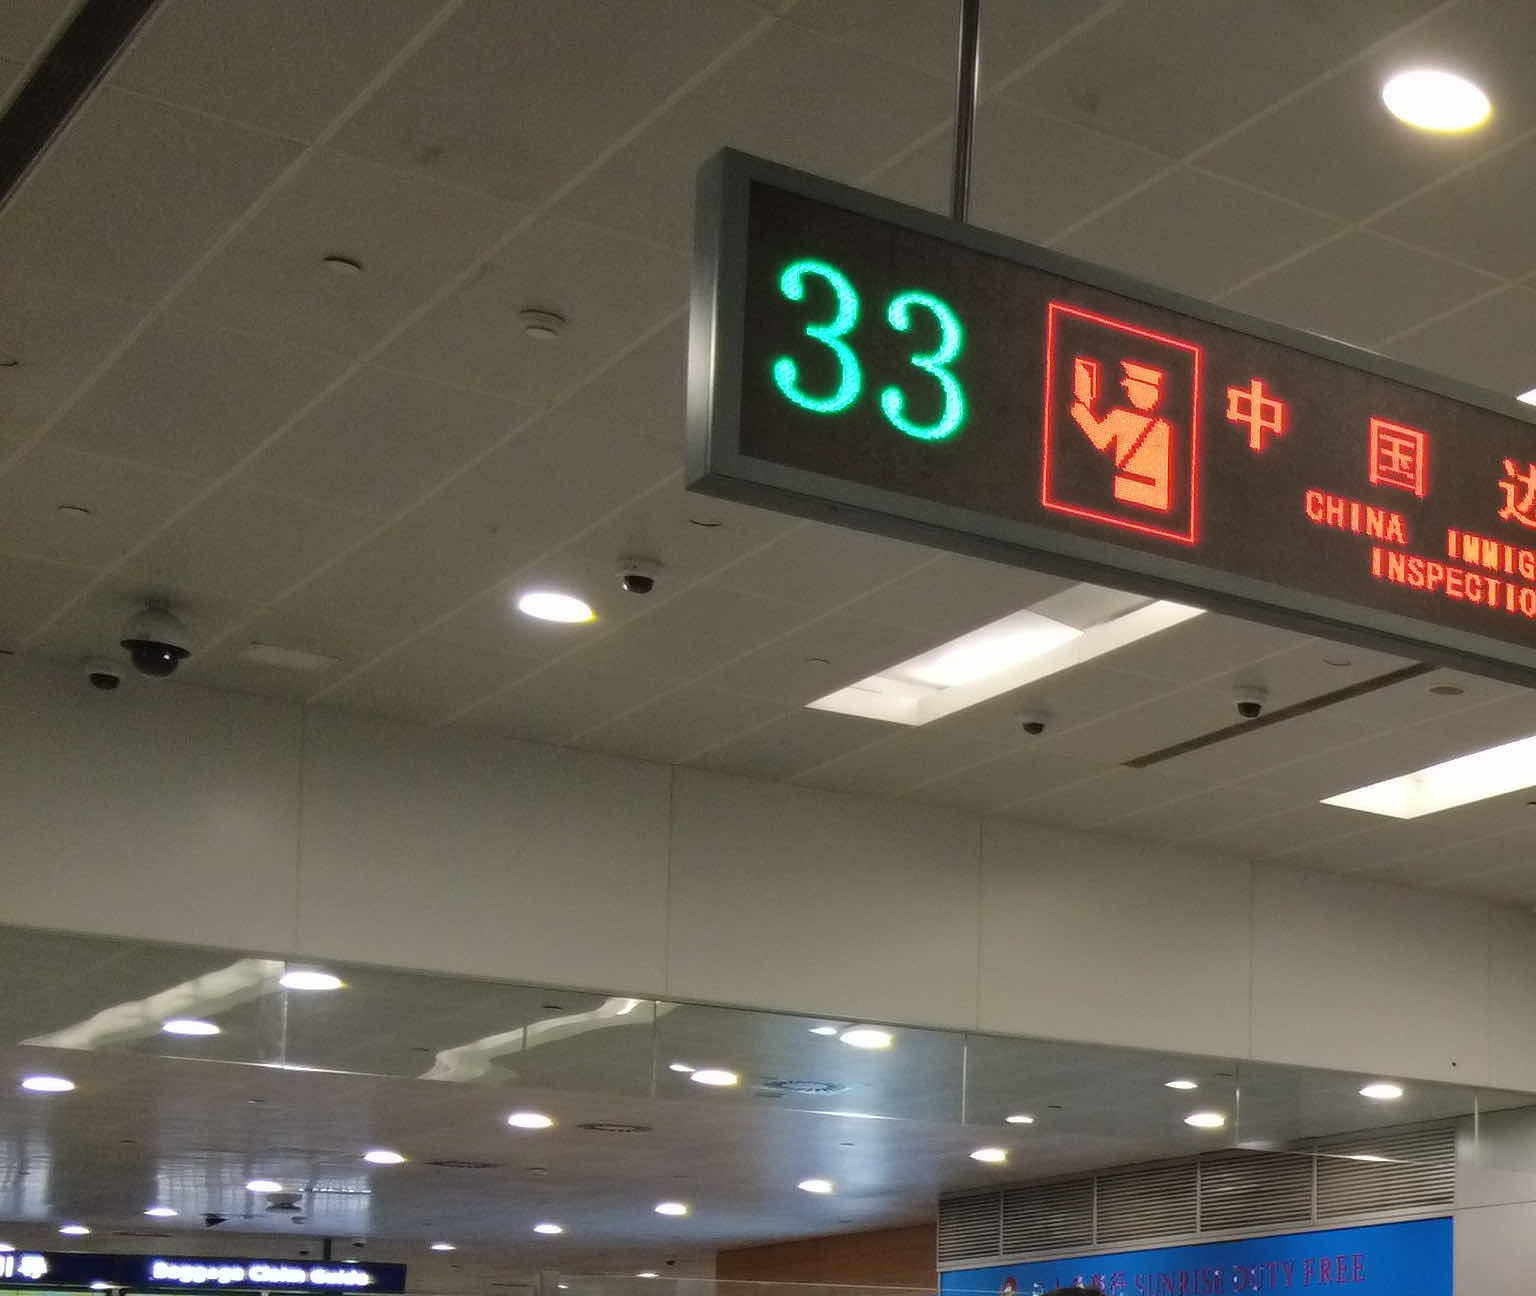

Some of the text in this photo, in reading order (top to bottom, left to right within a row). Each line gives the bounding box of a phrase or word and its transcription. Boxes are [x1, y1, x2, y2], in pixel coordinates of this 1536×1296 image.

[774, 260, 965, 440] 33
[1305, 489, 1408, 545] CHINA
[1233, 1258, 1297, 1292] DUTY
[1303, 1253, 1366, 1285] FREE
